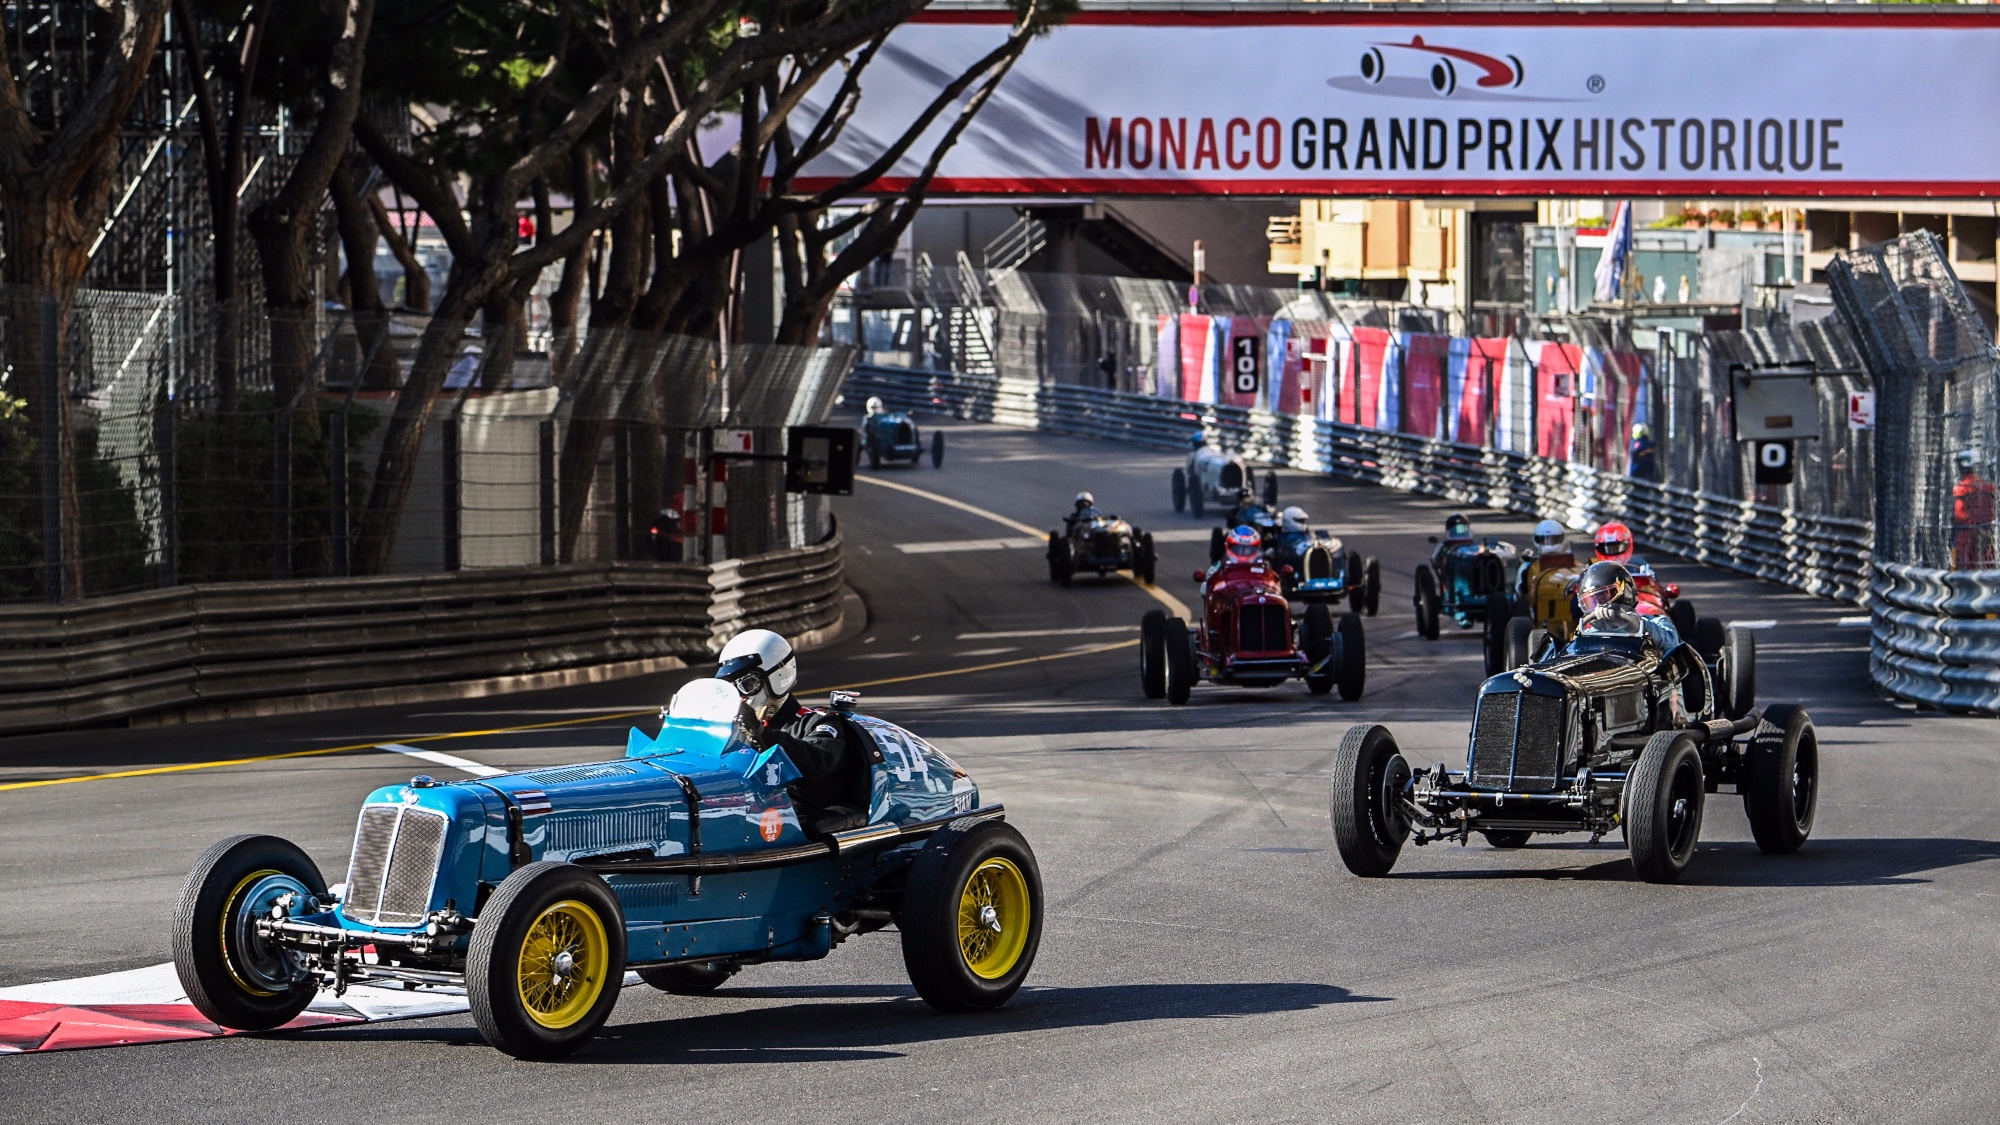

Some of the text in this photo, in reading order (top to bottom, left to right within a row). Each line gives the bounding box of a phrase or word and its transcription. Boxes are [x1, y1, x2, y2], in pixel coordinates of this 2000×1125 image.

[1084, 116, 1281, 171] MONACO
[1573, 117, 1844, 174] HISTORIQUE
[1237, 338, 1255, 391] 100
[1761, 443, 1786, 468] 0
[872, 727, 929, 783] 54
[954, 793, 972, 814] SIAM
